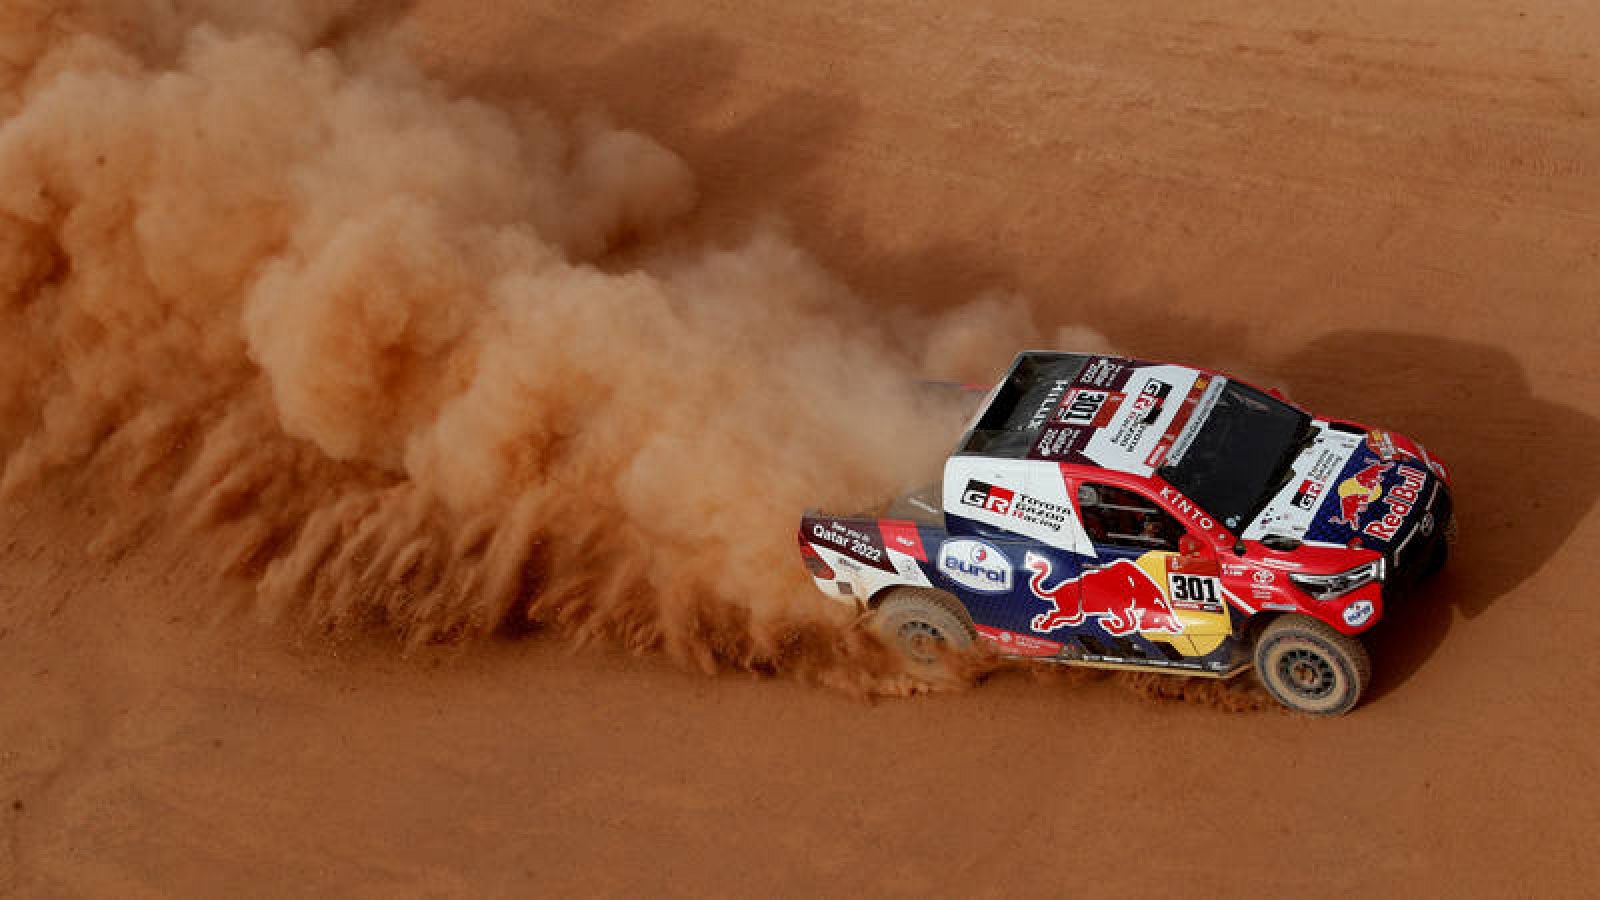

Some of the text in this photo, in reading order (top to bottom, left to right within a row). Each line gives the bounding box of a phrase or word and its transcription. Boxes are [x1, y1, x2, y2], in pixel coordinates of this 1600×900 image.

[1027, 380, 1069, 430] HILUX
[1063, 391, 1105, 419] 301
[1387, 464, 1428, 505] Bull
[961, 489, 1010, 515] GR
[1015, 502, 1065, 522] GAZOO
[1019, 494, 1070, 515] TOYOTA
[1160, 485, 1214, 530] KINTO
[1012, 510, 1060, 532] Racing
[1361, 496, 1414, 542] Red
[812, 523, 849, 547] Qatar
[850, 540, 881, 562] 2022
[1172, 575, 1220, 603] 301
